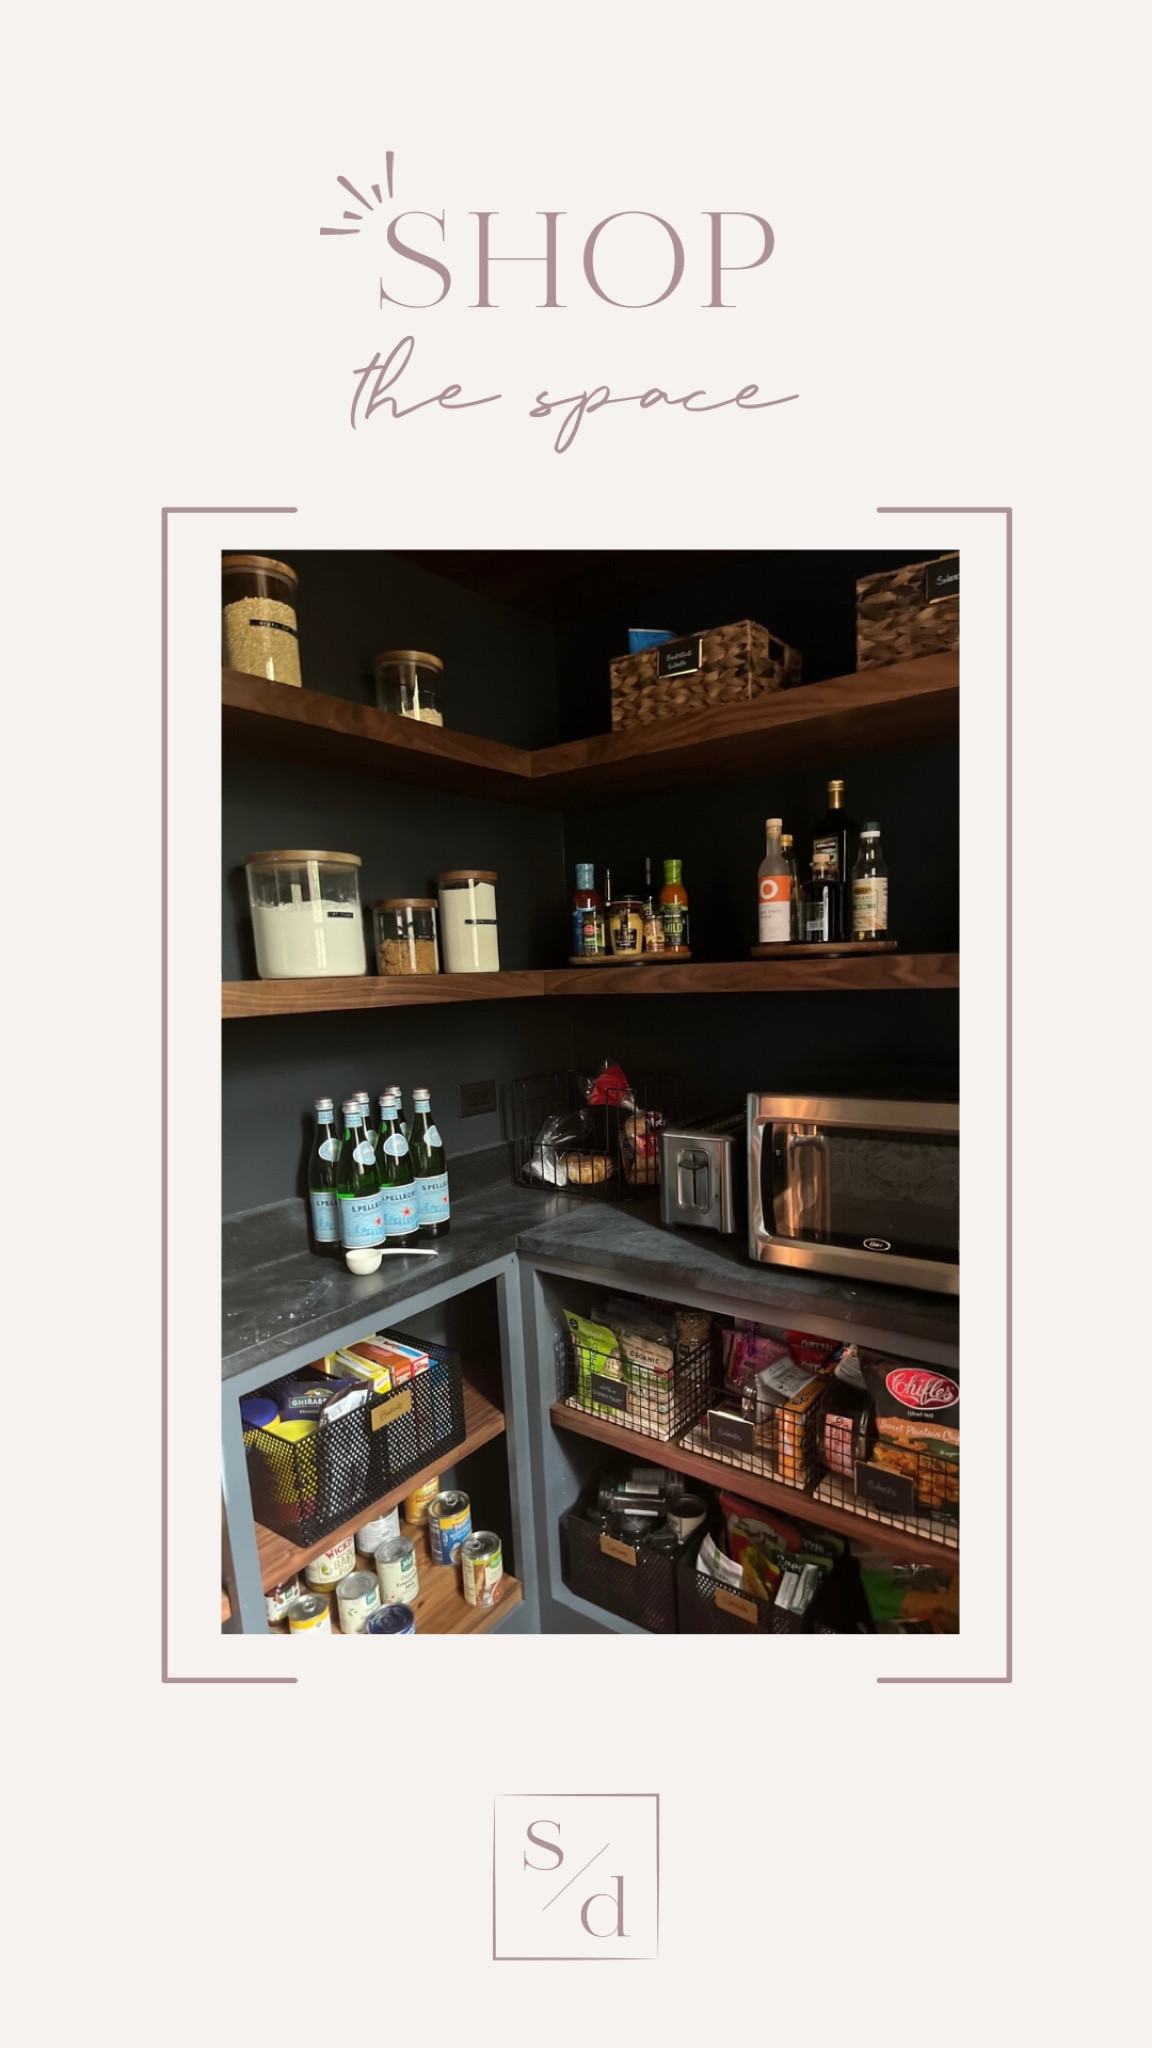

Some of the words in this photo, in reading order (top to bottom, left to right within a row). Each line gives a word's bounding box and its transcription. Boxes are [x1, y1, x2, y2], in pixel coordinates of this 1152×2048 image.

[629, 1350, 660, 1364] ORGANIC
[880, 1420, 903, 1433] Sweet
[906, 1424, 941, 1438] Plantain
